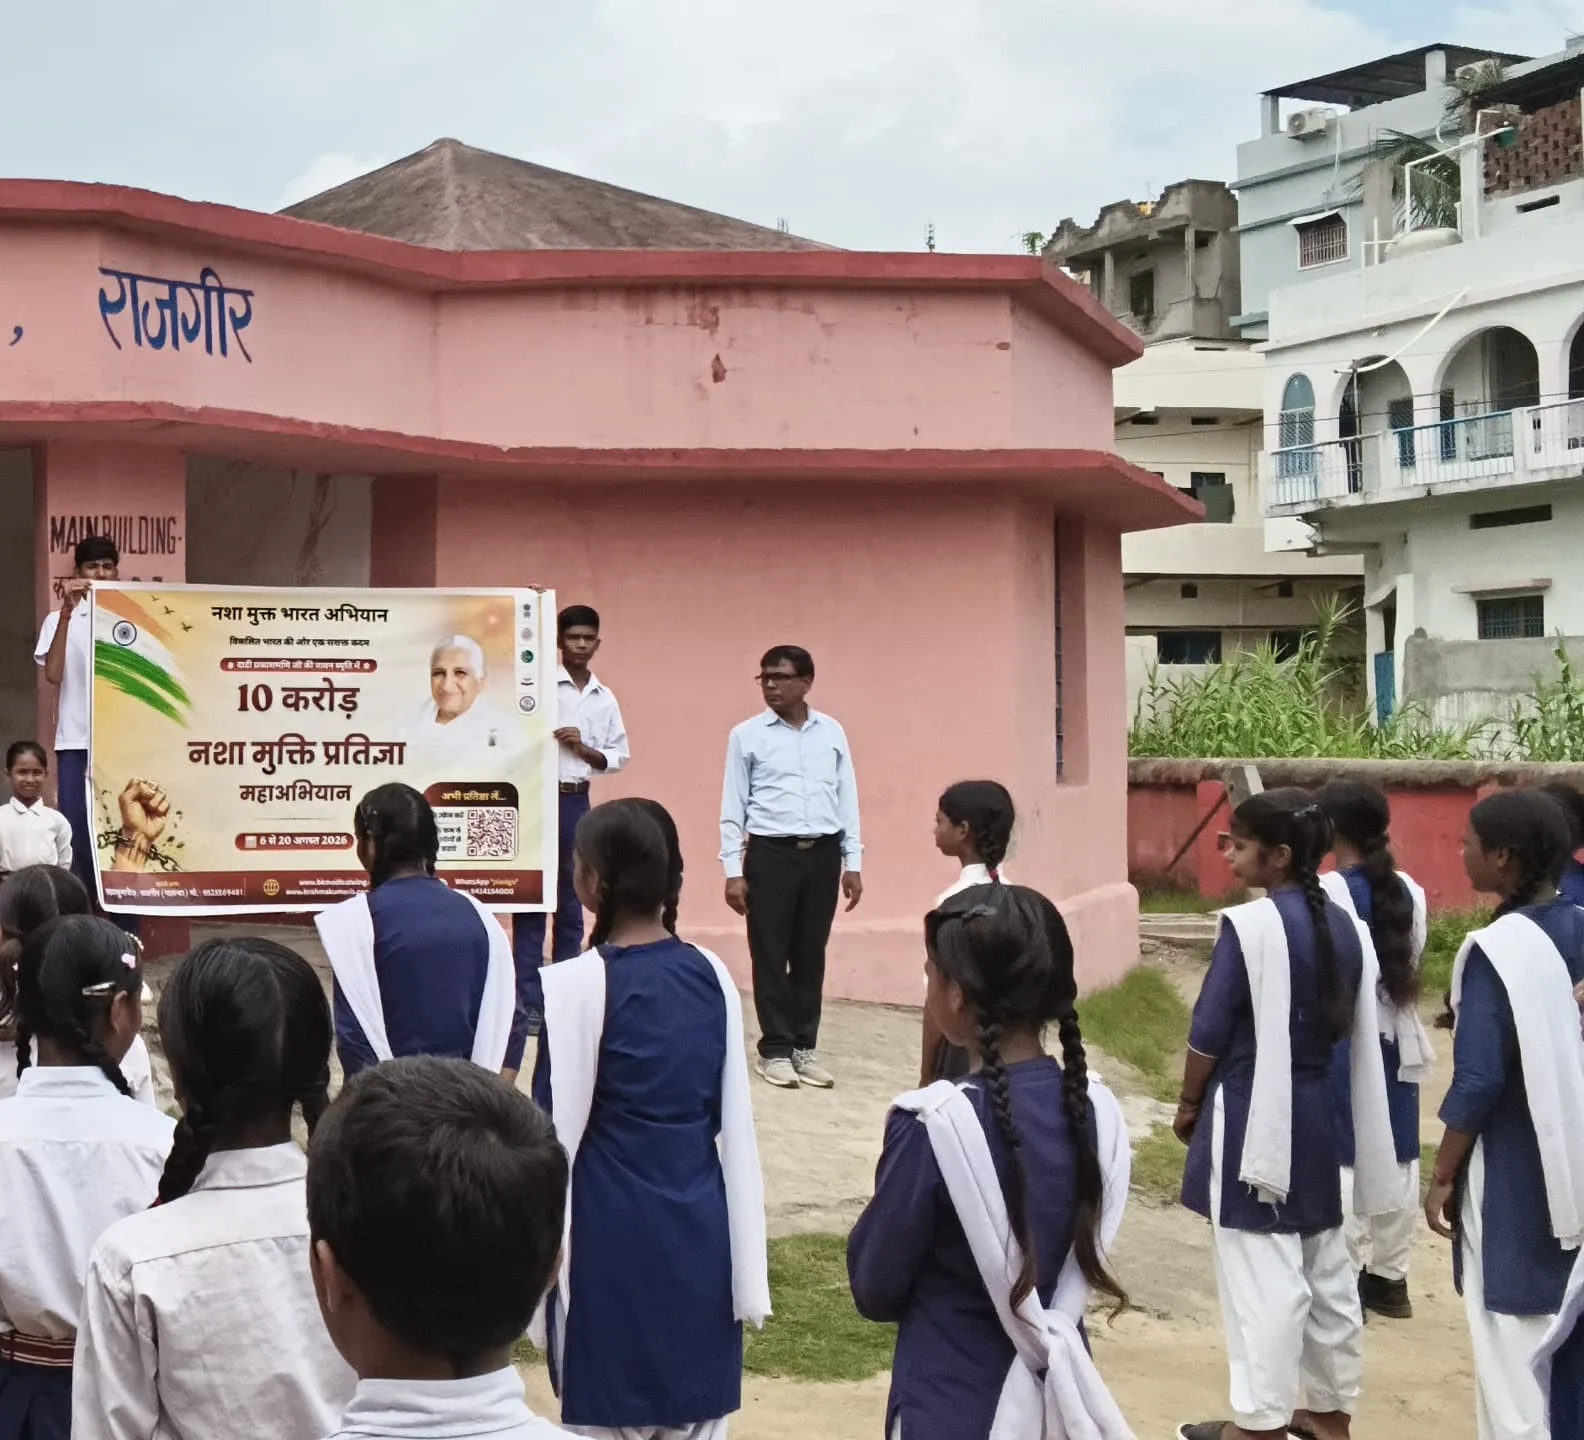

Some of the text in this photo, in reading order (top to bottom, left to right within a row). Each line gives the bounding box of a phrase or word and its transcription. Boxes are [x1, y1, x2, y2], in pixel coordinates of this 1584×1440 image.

[98, 266, 254, 363] राजगीर
[50, 515, 99, 553] MAIN
[211, 603, 388, 626] नशा मुक्त भारत अभियान
[263, 637, 282, 647] भारत
[283, 635, 294, 646] की
[237, 659, 252, 670] दादी
[237, 677, 360, 720] 10 करोड़
[186, 732, 407, 775] नशा मुक्ति प्रतिज्ञा
[238, 778, 352, 804] महाअभियान
[441, 790, 461, 801] अभी
[260, 834, 348, 846] 6 से 20 अगस्त 2026
